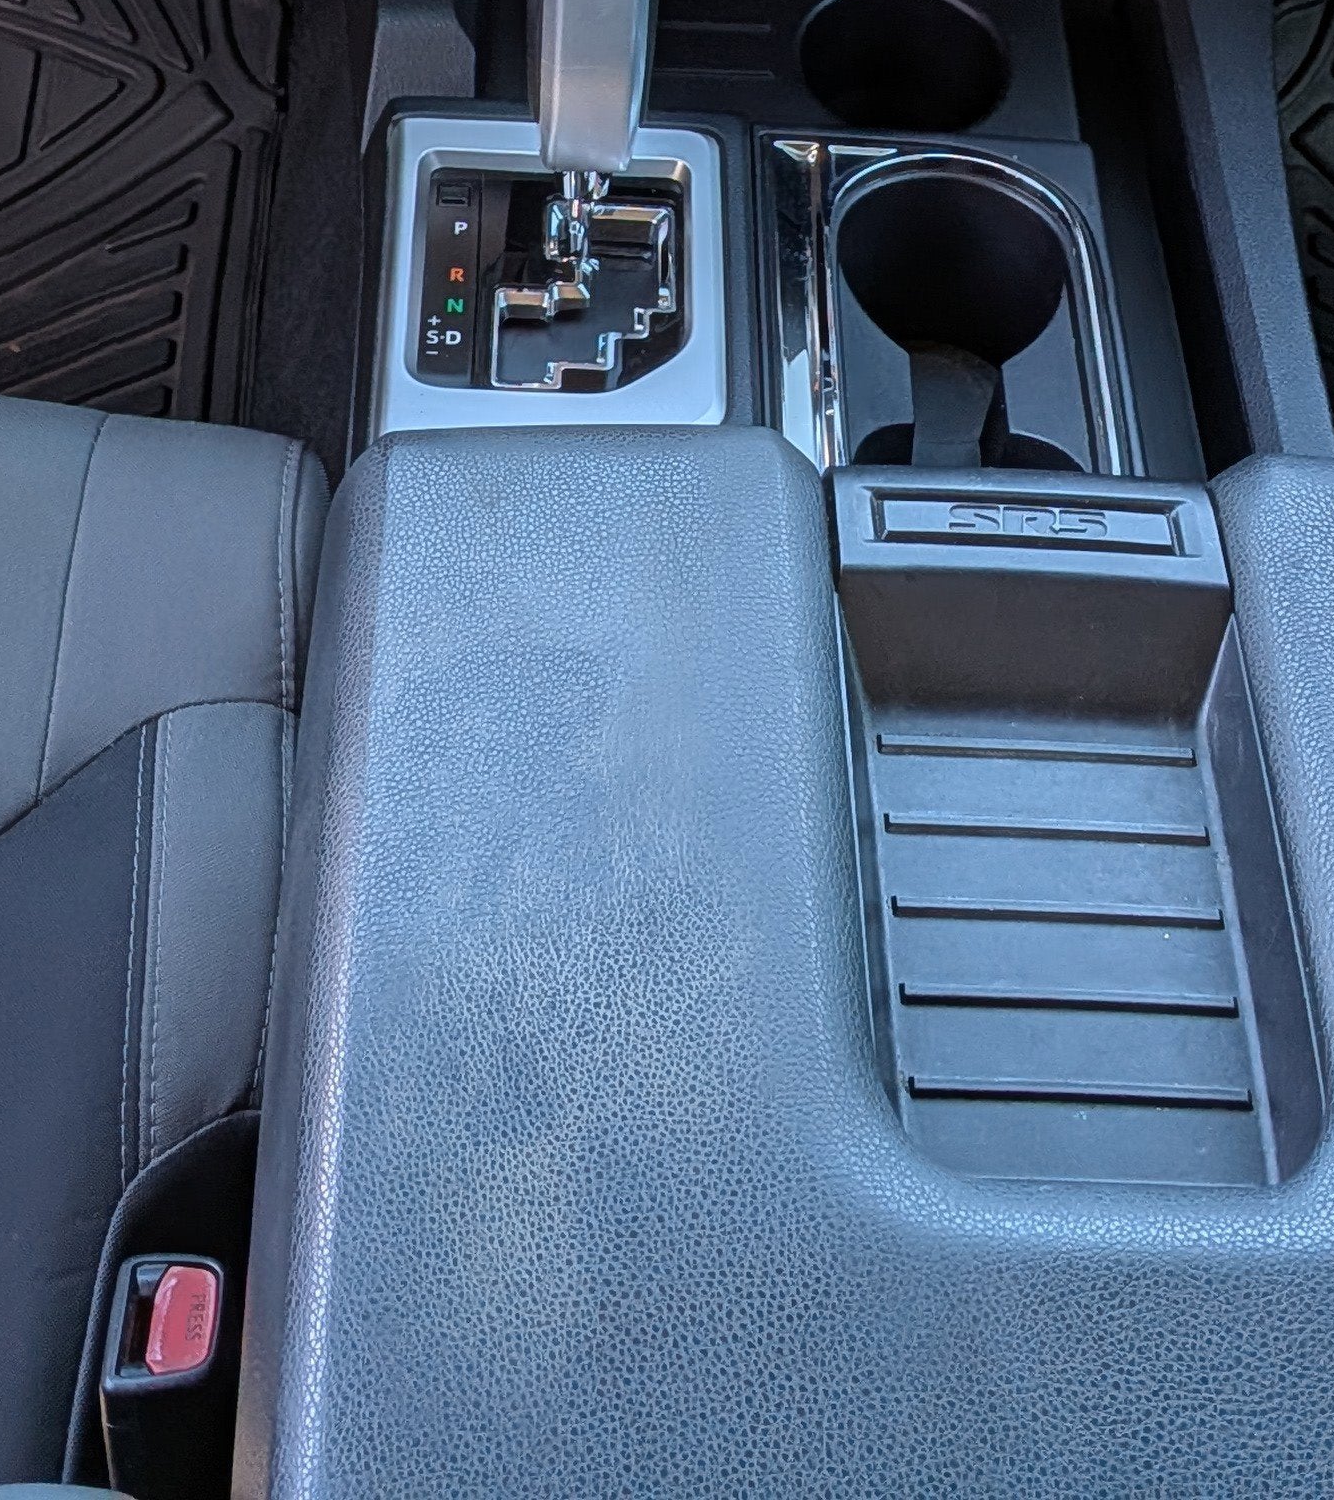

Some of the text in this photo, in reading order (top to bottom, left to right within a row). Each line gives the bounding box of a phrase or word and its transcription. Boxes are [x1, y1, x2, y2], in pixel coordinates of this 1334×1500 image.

[454, 221, 468, 235] P
[449, 267, 465, 282] R
[447, 299, 464, 313] N
[948, 503, 1108, 538] SR5
[185, 1294, 207, 1341] PRESS
